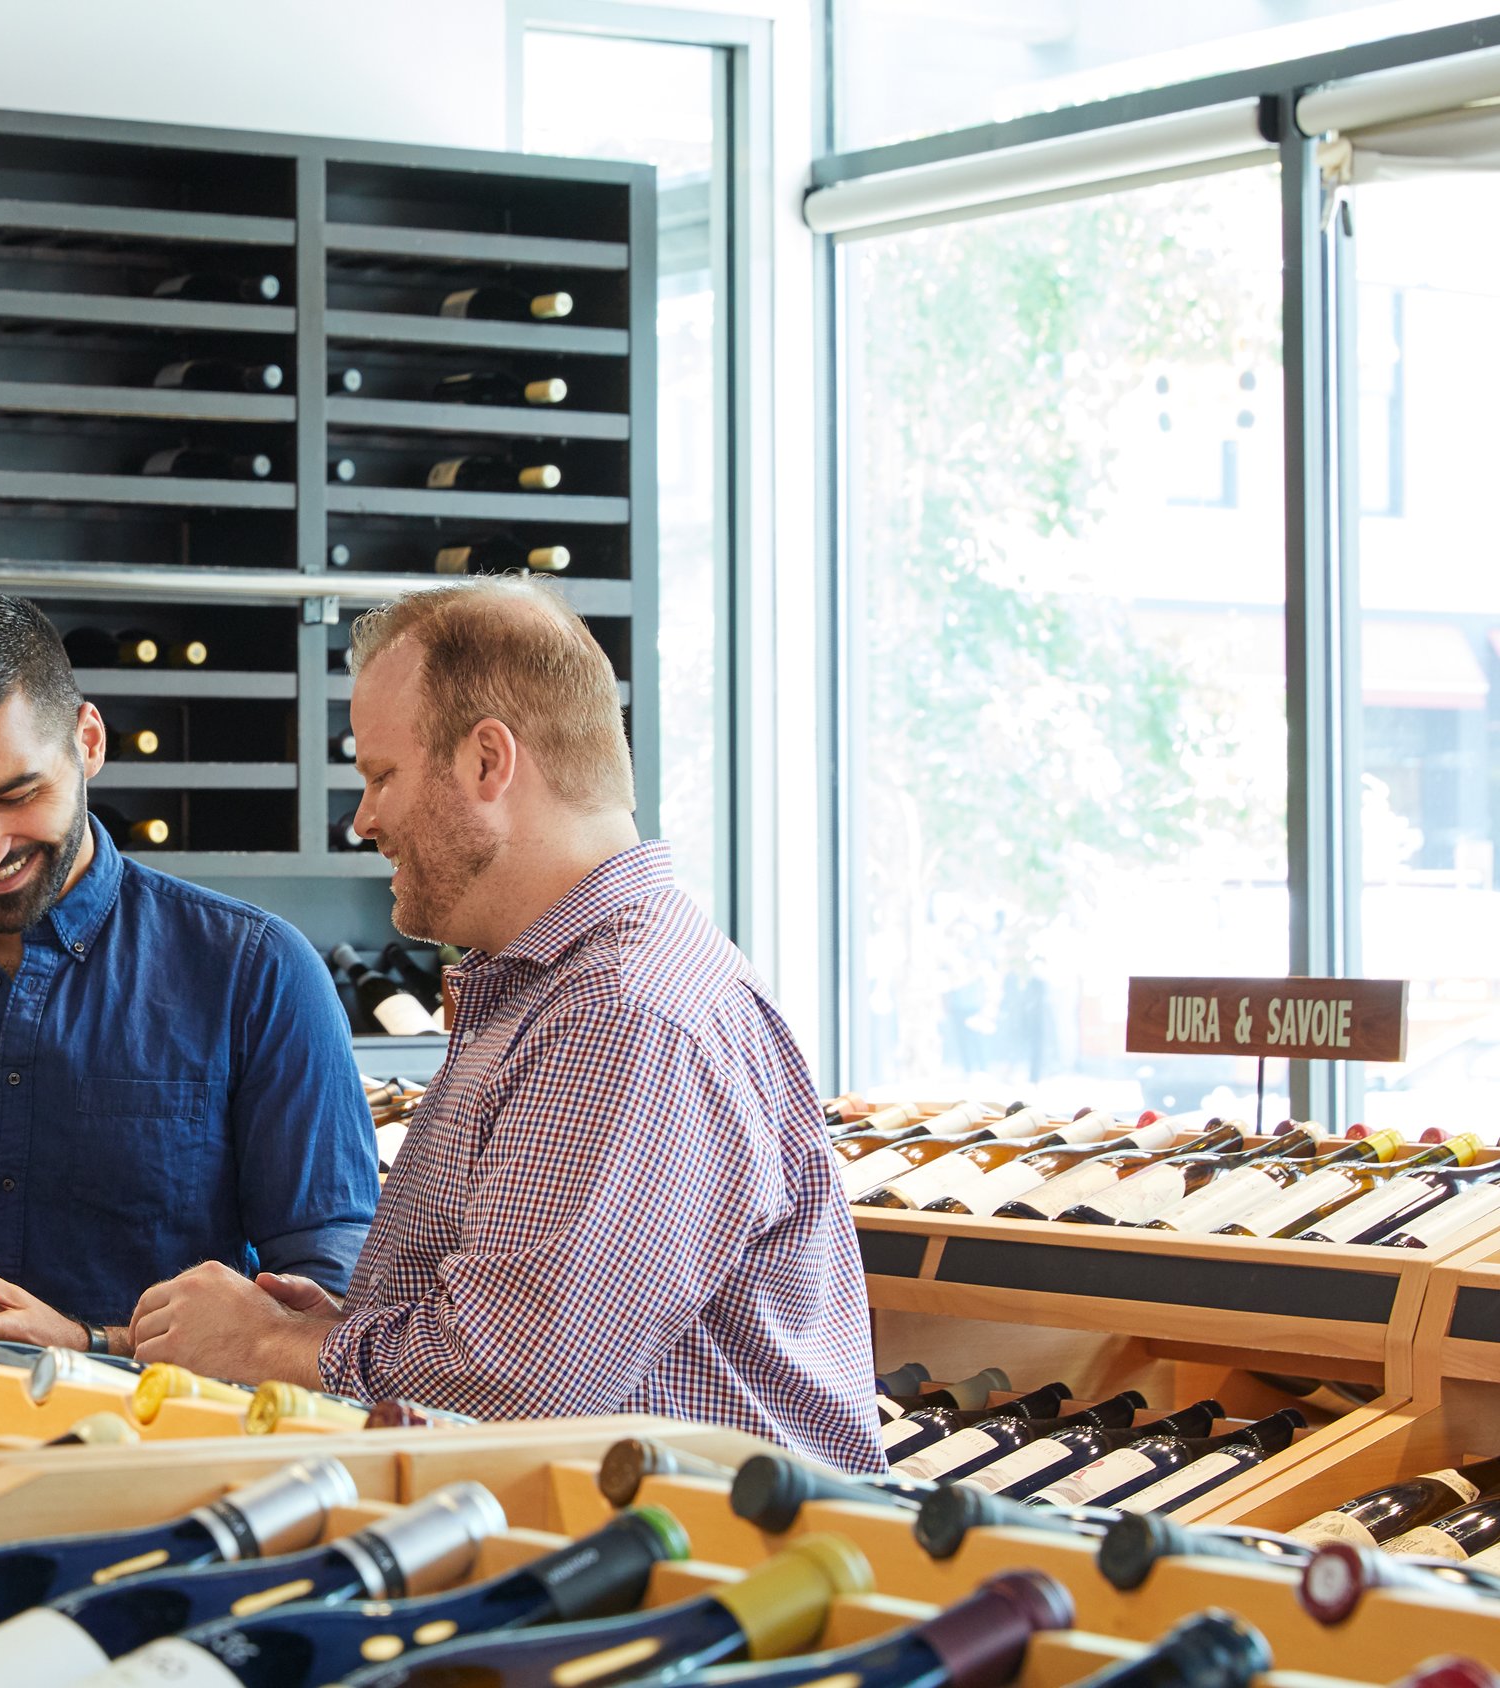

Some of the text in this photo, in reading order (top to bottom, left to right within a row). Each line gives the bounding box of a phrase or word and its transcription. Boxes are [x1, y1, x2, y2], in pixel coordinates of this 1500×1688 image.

[1165, 995, 1353, 1048] JURA & SAVOIE
